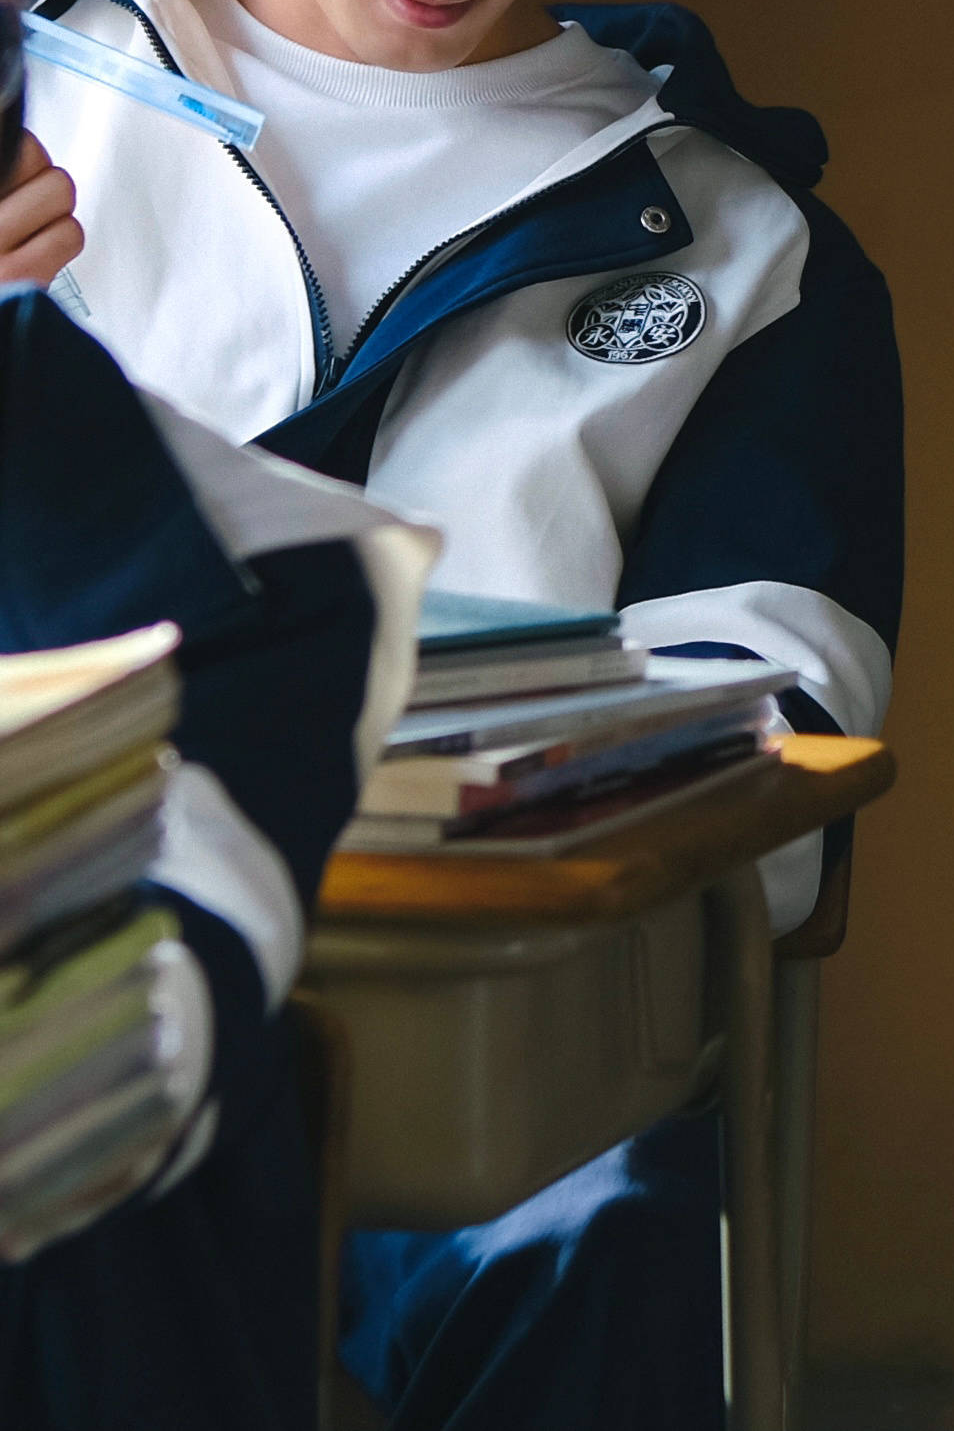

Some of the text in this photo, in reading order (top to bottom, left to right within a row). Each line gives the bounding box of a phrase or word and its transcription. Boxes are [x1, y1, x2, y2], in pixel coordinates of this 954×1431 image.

[581, 325, 677, 346] 永 安
[608, 350, 639, 361] 1967
